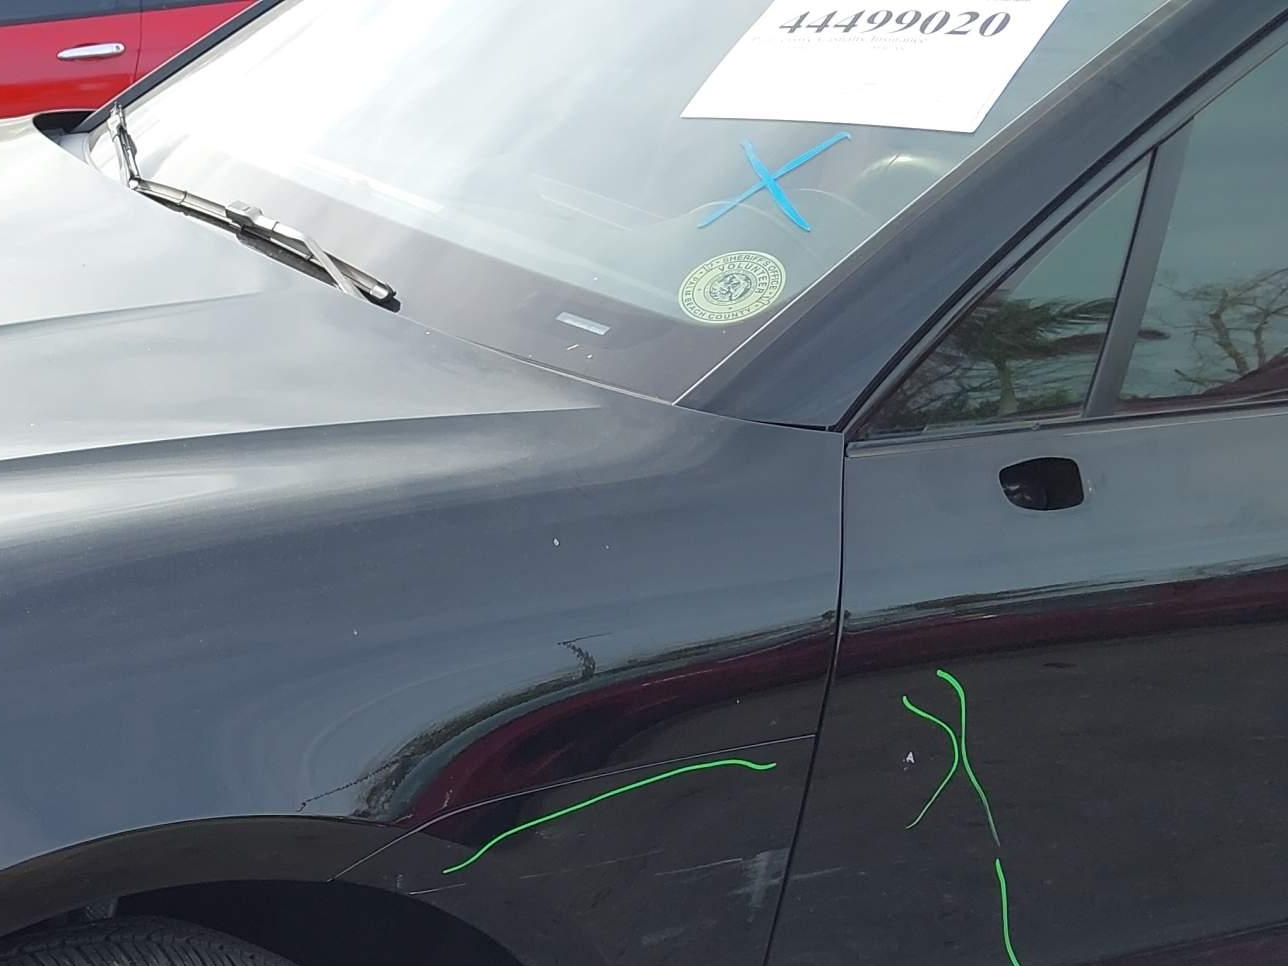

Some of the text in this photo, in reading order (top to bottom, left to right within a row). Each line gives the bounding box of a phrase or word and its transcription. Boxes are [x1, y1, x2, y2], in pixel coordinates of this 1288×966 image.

[779, 9, 1012, 37] 44499020
[718, 262, 768, 294] VOLUNTEER
[707, 307, 751, 320] COUNTY
